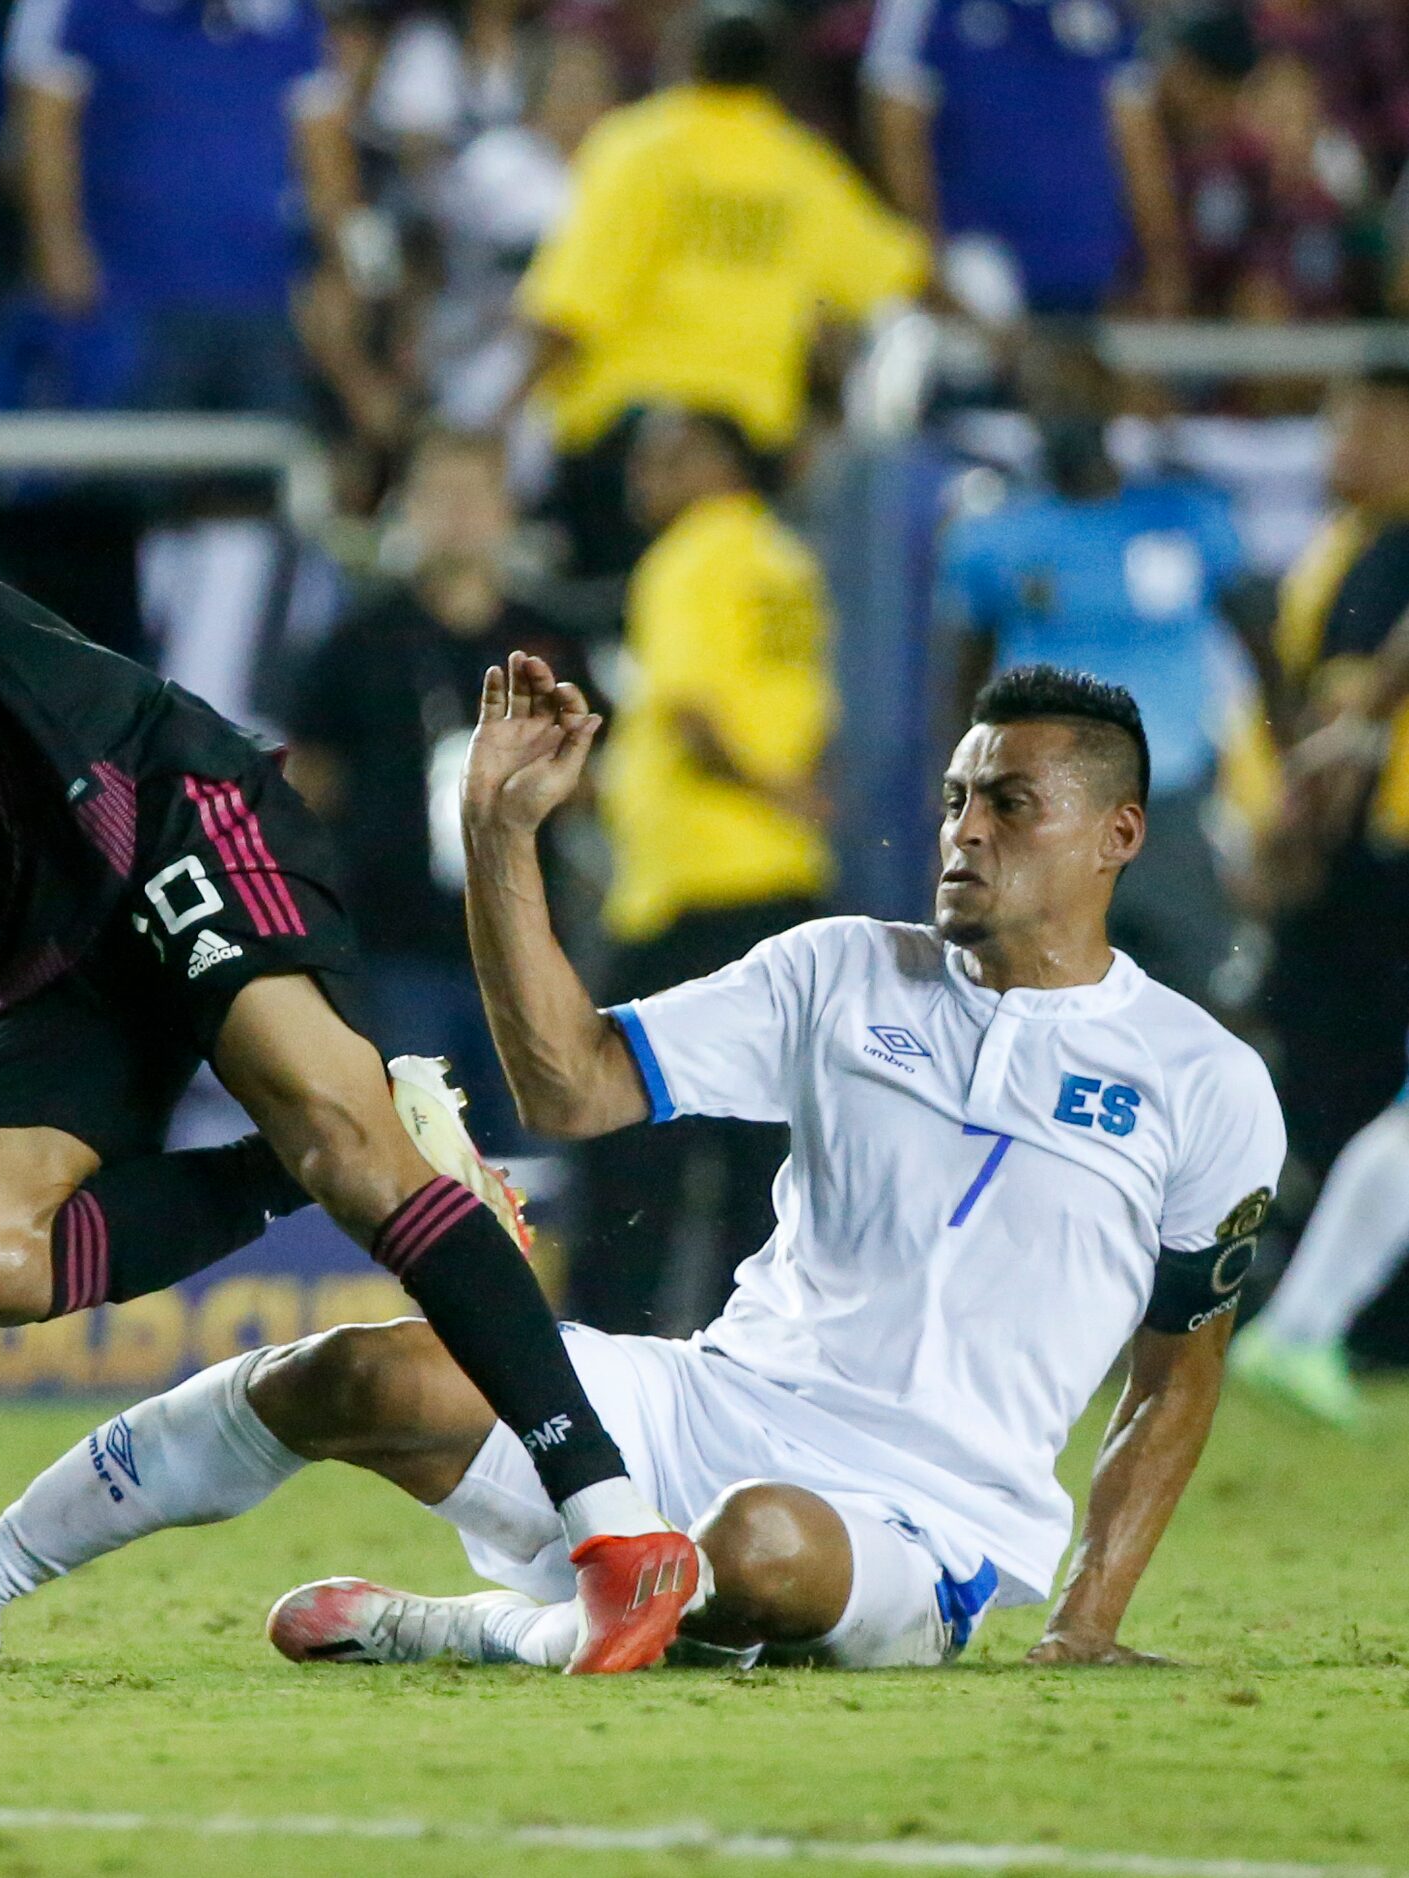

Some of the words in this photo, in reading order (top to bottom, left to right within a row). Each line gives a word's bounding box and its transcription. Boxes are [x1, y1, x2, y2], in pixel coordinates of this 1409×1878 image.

[188, 944, 244, 979] adidas
[863, 1045, 916, 1074] umbro
[1052, 1072, 1142, 1137] ES
[947, 1123, 1014, 1227] 7
[89, 1431, 124, 1504] mbro
